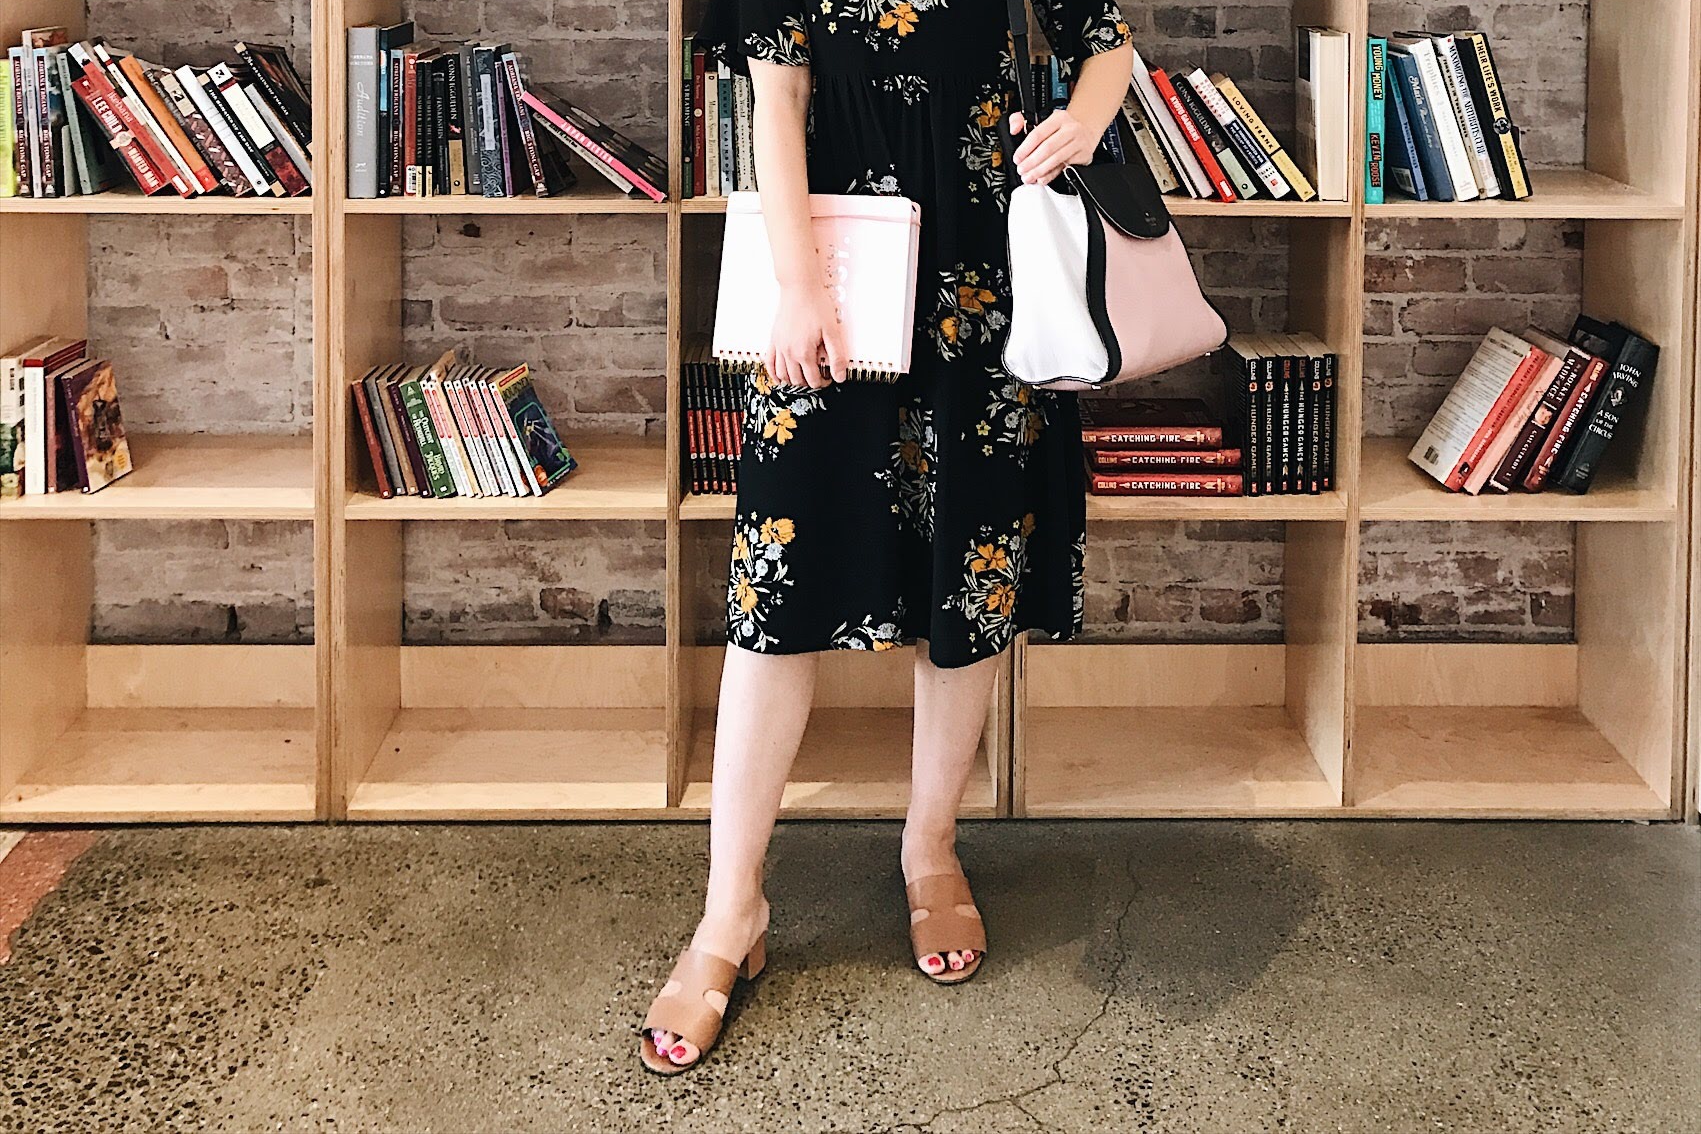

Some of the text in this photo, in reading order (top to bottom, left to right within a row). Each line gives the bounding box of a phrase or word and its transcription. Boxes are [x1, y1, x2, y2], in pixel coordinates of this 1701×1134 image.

[14, 61, 23, 114] ADRIANA TRIGIANI
[38, 61, 46, 87] ADRIANA
[447, 58, 458, 120] CONN IGGULDEN
[1372, 45, 1384, 99] YOUNG MONEY
[1475, 40, 1501, 116] THEIR LIFE'S WORK
[106, 91, 134, 124] Ikebana
[356, 81, 373, 137] Audition
[436, 96, 446, 139] FRANKENSTEIN
[1169, 95, 1201, 143] KYOTO GARDENS
[1175, 81, 1214, 137] CONN IGGULDEN
[1231, 95, 1274, 150] LOVING FRANK
[723, 122, 732, 182] PLAINSONG
[1370, 133, 1382, 187] KEVIN ROOSE
[1554, 371, 1579, 405] ROCKET
[1612, 370, 1640, 389] IRVING
[1617, 362, 1643, 379] JOHN
[1110, 434, 1181, 443] CATCHING FIRE
[1250, 405, 1258, 478] HUNGER GAMES
[1549, 389, 1591, 456] CATCHING FIRE
[1588, 423, 1615, 440] CIRCUS
[1097, 455, 1201, 464] COLLINS CATCHING FIRE
[1265, 445, 1273, 477] GAMES
[1097, 481, 1201, 490] COLLINS CATCHING FIRE
